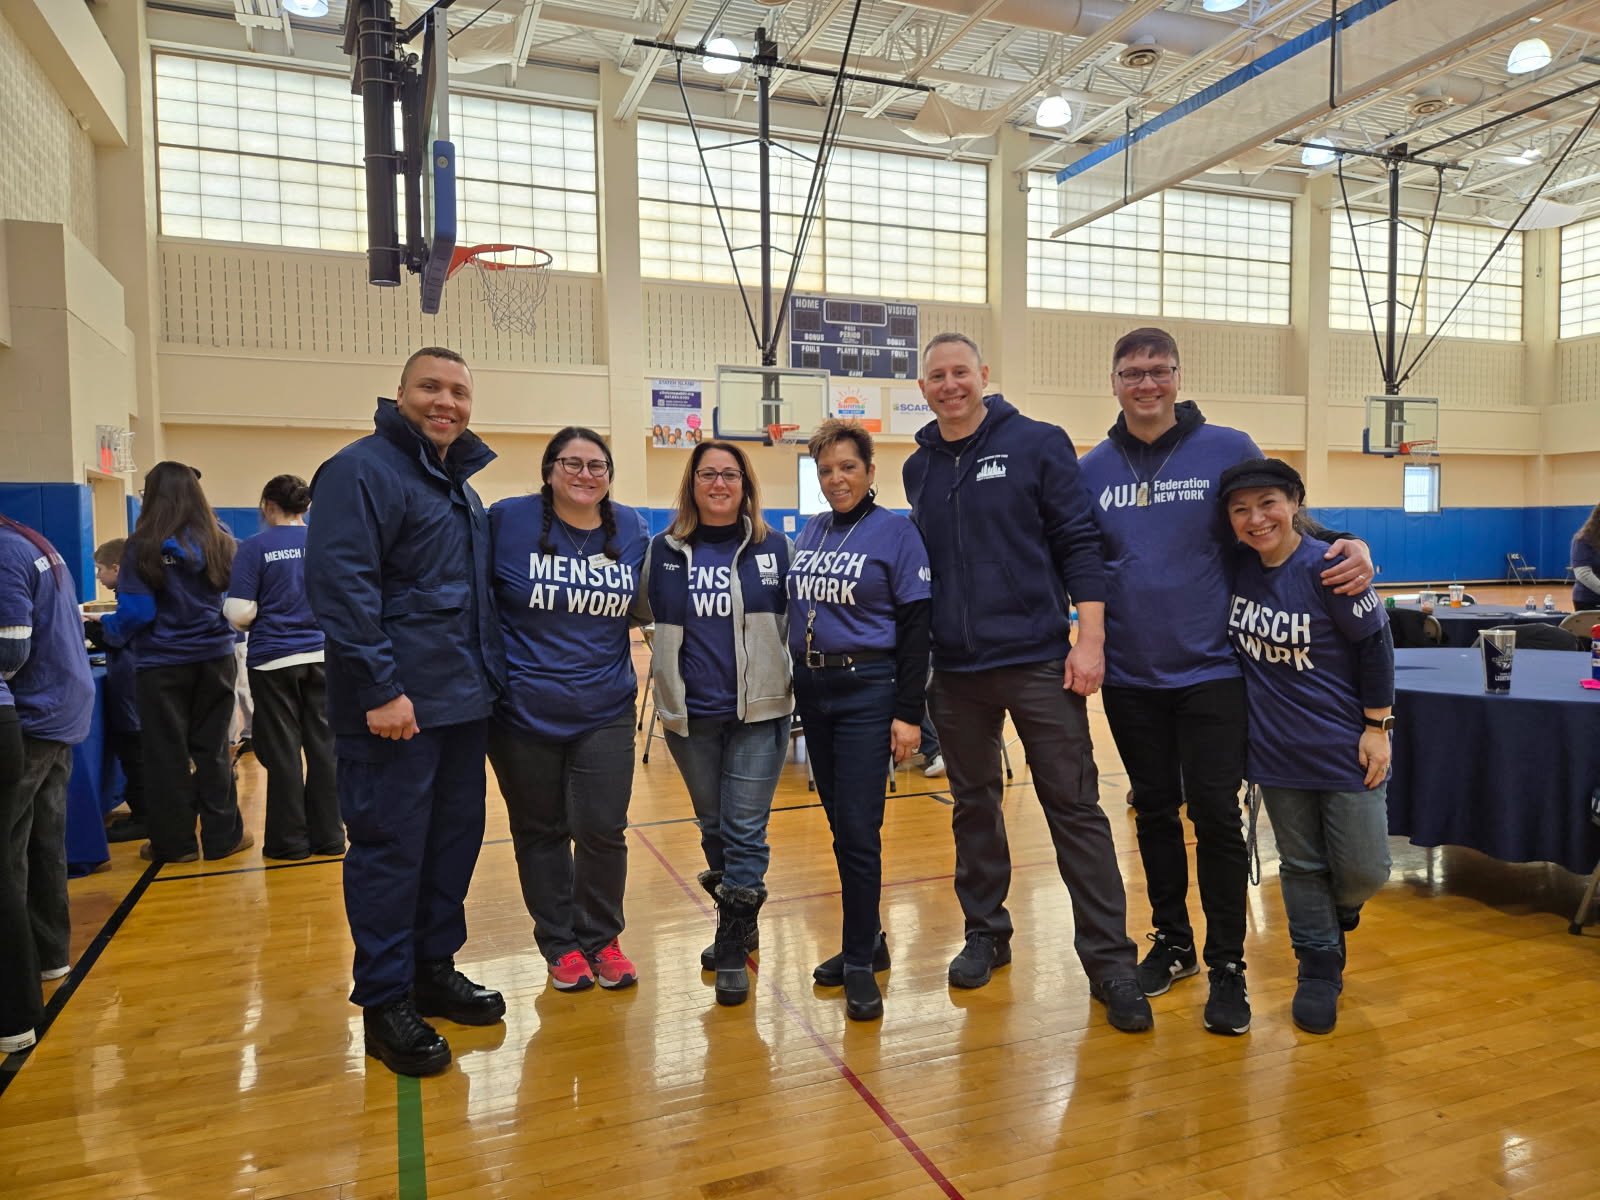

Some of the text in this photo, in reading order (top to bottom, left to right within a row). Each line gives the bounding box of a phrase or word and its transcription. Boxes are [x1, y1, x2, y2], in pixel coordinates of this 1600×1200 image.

[795, 298, 819, 309] HOME
[887, 305, 917, 316] VISITOR
[804, 332, 824, 341] BONUS
[839, 331, 860, 339] PERIOD
[801, 344, 820, 353] FOULS
[836, 347, 880, 356] PLAYER FOULS
[890, 350, 909, 358] FOULS
[900, 403, 932, 412] SCAR
[1154, 477, 1210, 492] Federation
[1154, 489, 1205, 503] NEW YORK
[264, 548, 302, 563] MENSCH
[529, 552, 634, 591] MENSCH
[795, 574, 858, 606] WORK
[528, 582, 633, 618] AT WORK
[1229, 594, 1311, 644] ENSCH
